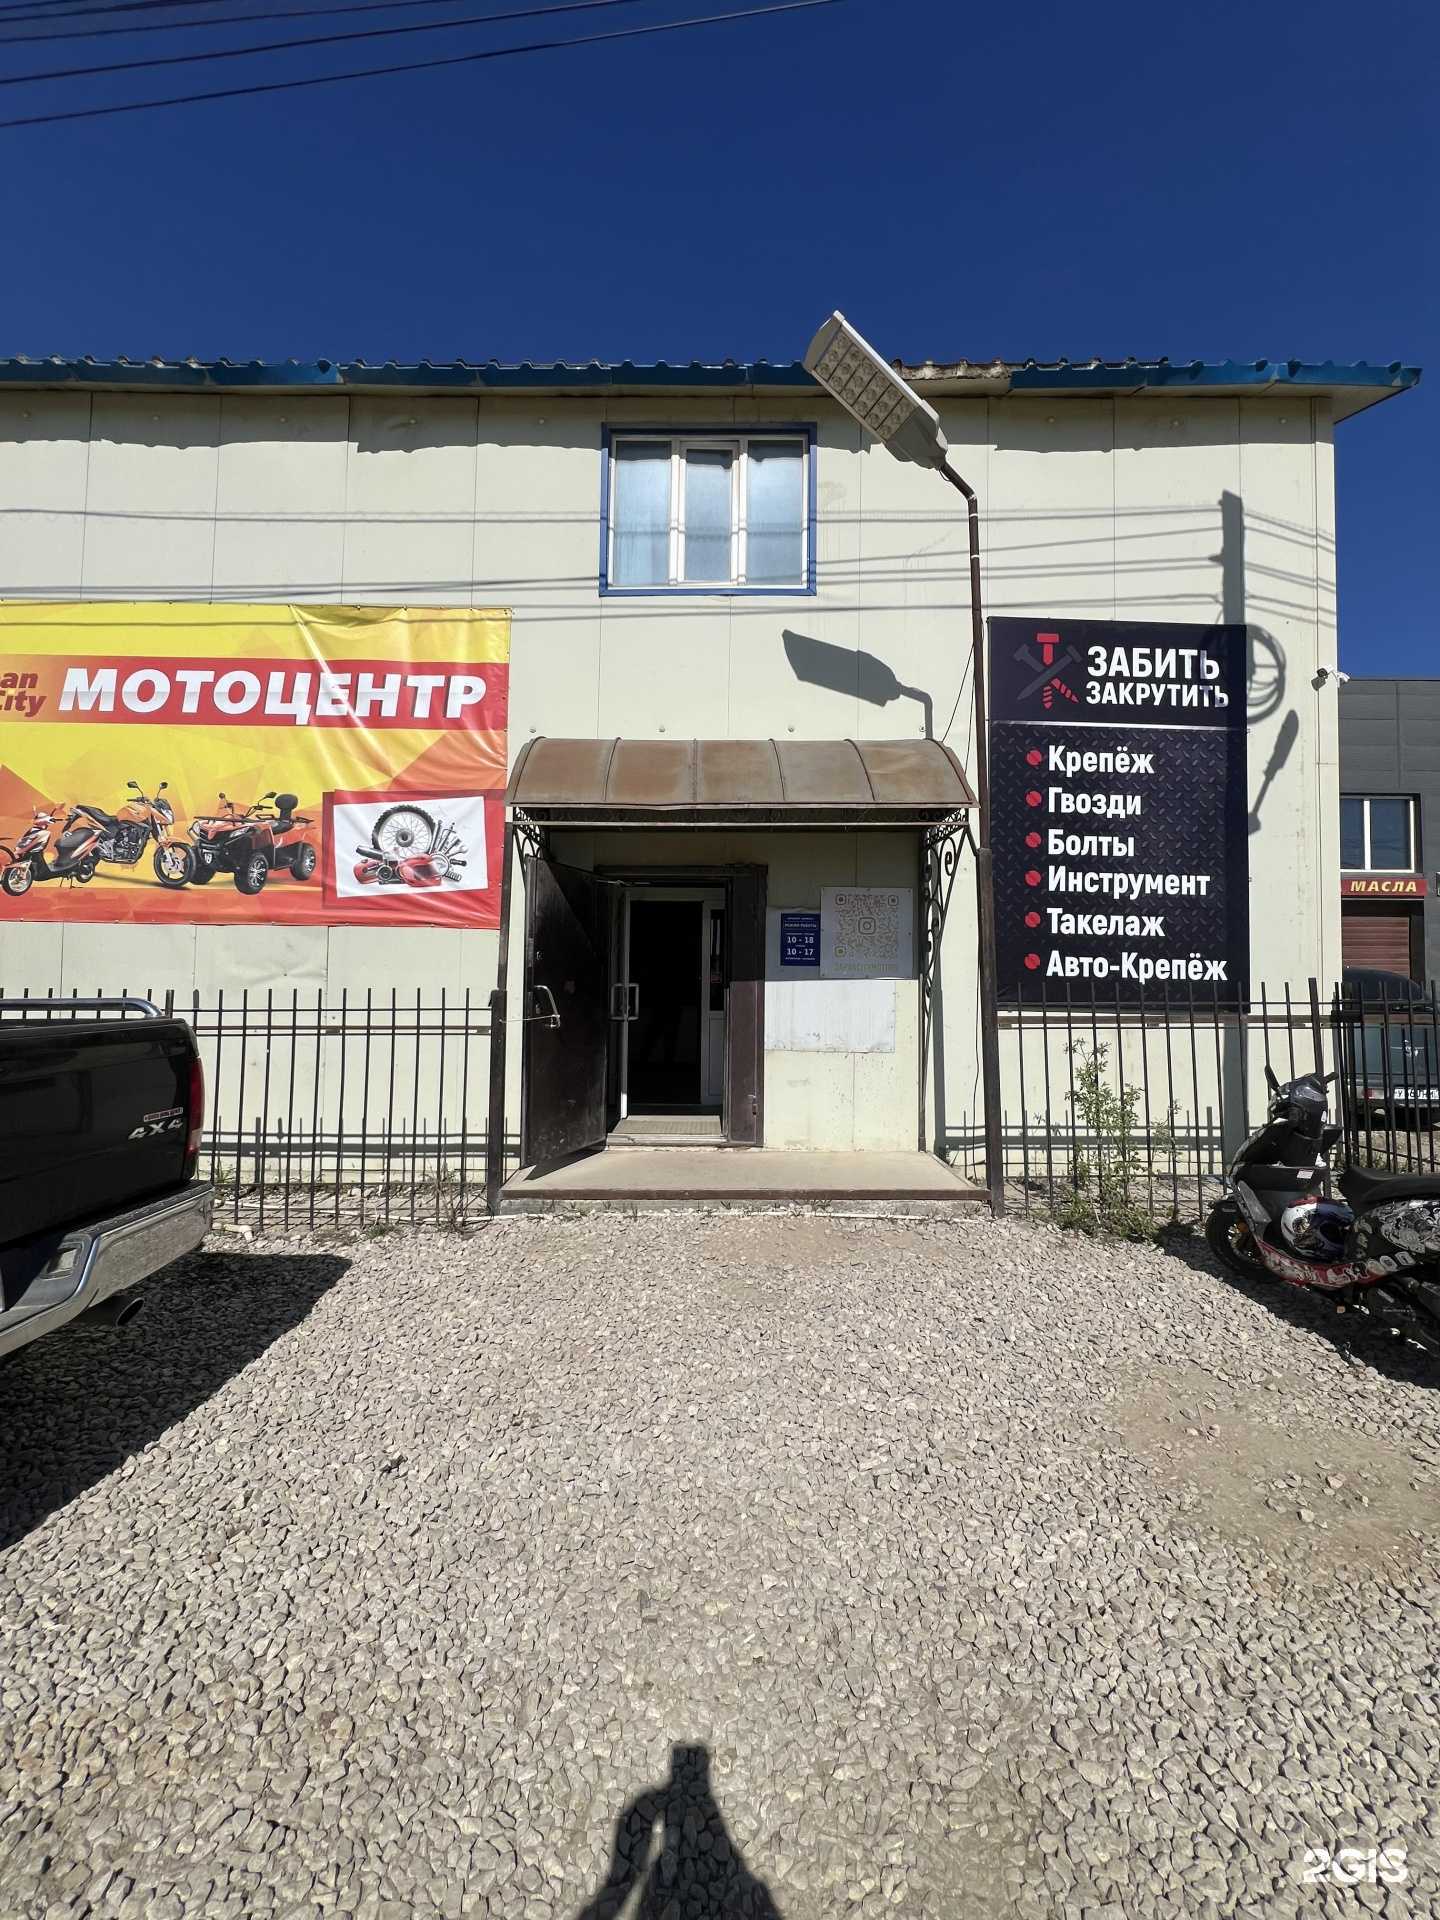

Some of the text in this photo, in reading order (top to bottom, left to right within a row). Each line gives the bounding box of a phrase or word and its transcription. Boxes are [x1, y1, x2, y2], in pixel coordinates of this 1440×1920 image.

[1087, 646, 1220, 680] ЗАБИТЬ
[58, 667, 487, 726] МОТОЦЕНТР
[1085, 681, 1229, 708] ЗАКРУТИТЬ
[1048, 745, 1155, 778] Крепёж
[1048, 787, 1142, 818] Гвозди
[1047, 829, 1135, 857] Болты
[1047, 866, 1211, 900] Инструмент
[1350, 880, 1418, 892] МАСЛА
[1046, 908, 1166, 937] Такелаж
[787, 936, 797, 944] 10
[804, 936, 814, 944] 18
[787, 948, 797, 956] 10
[804, 948, 815, 956] 17
[1046, 949, 1228, 985] Авто-Крепёж
